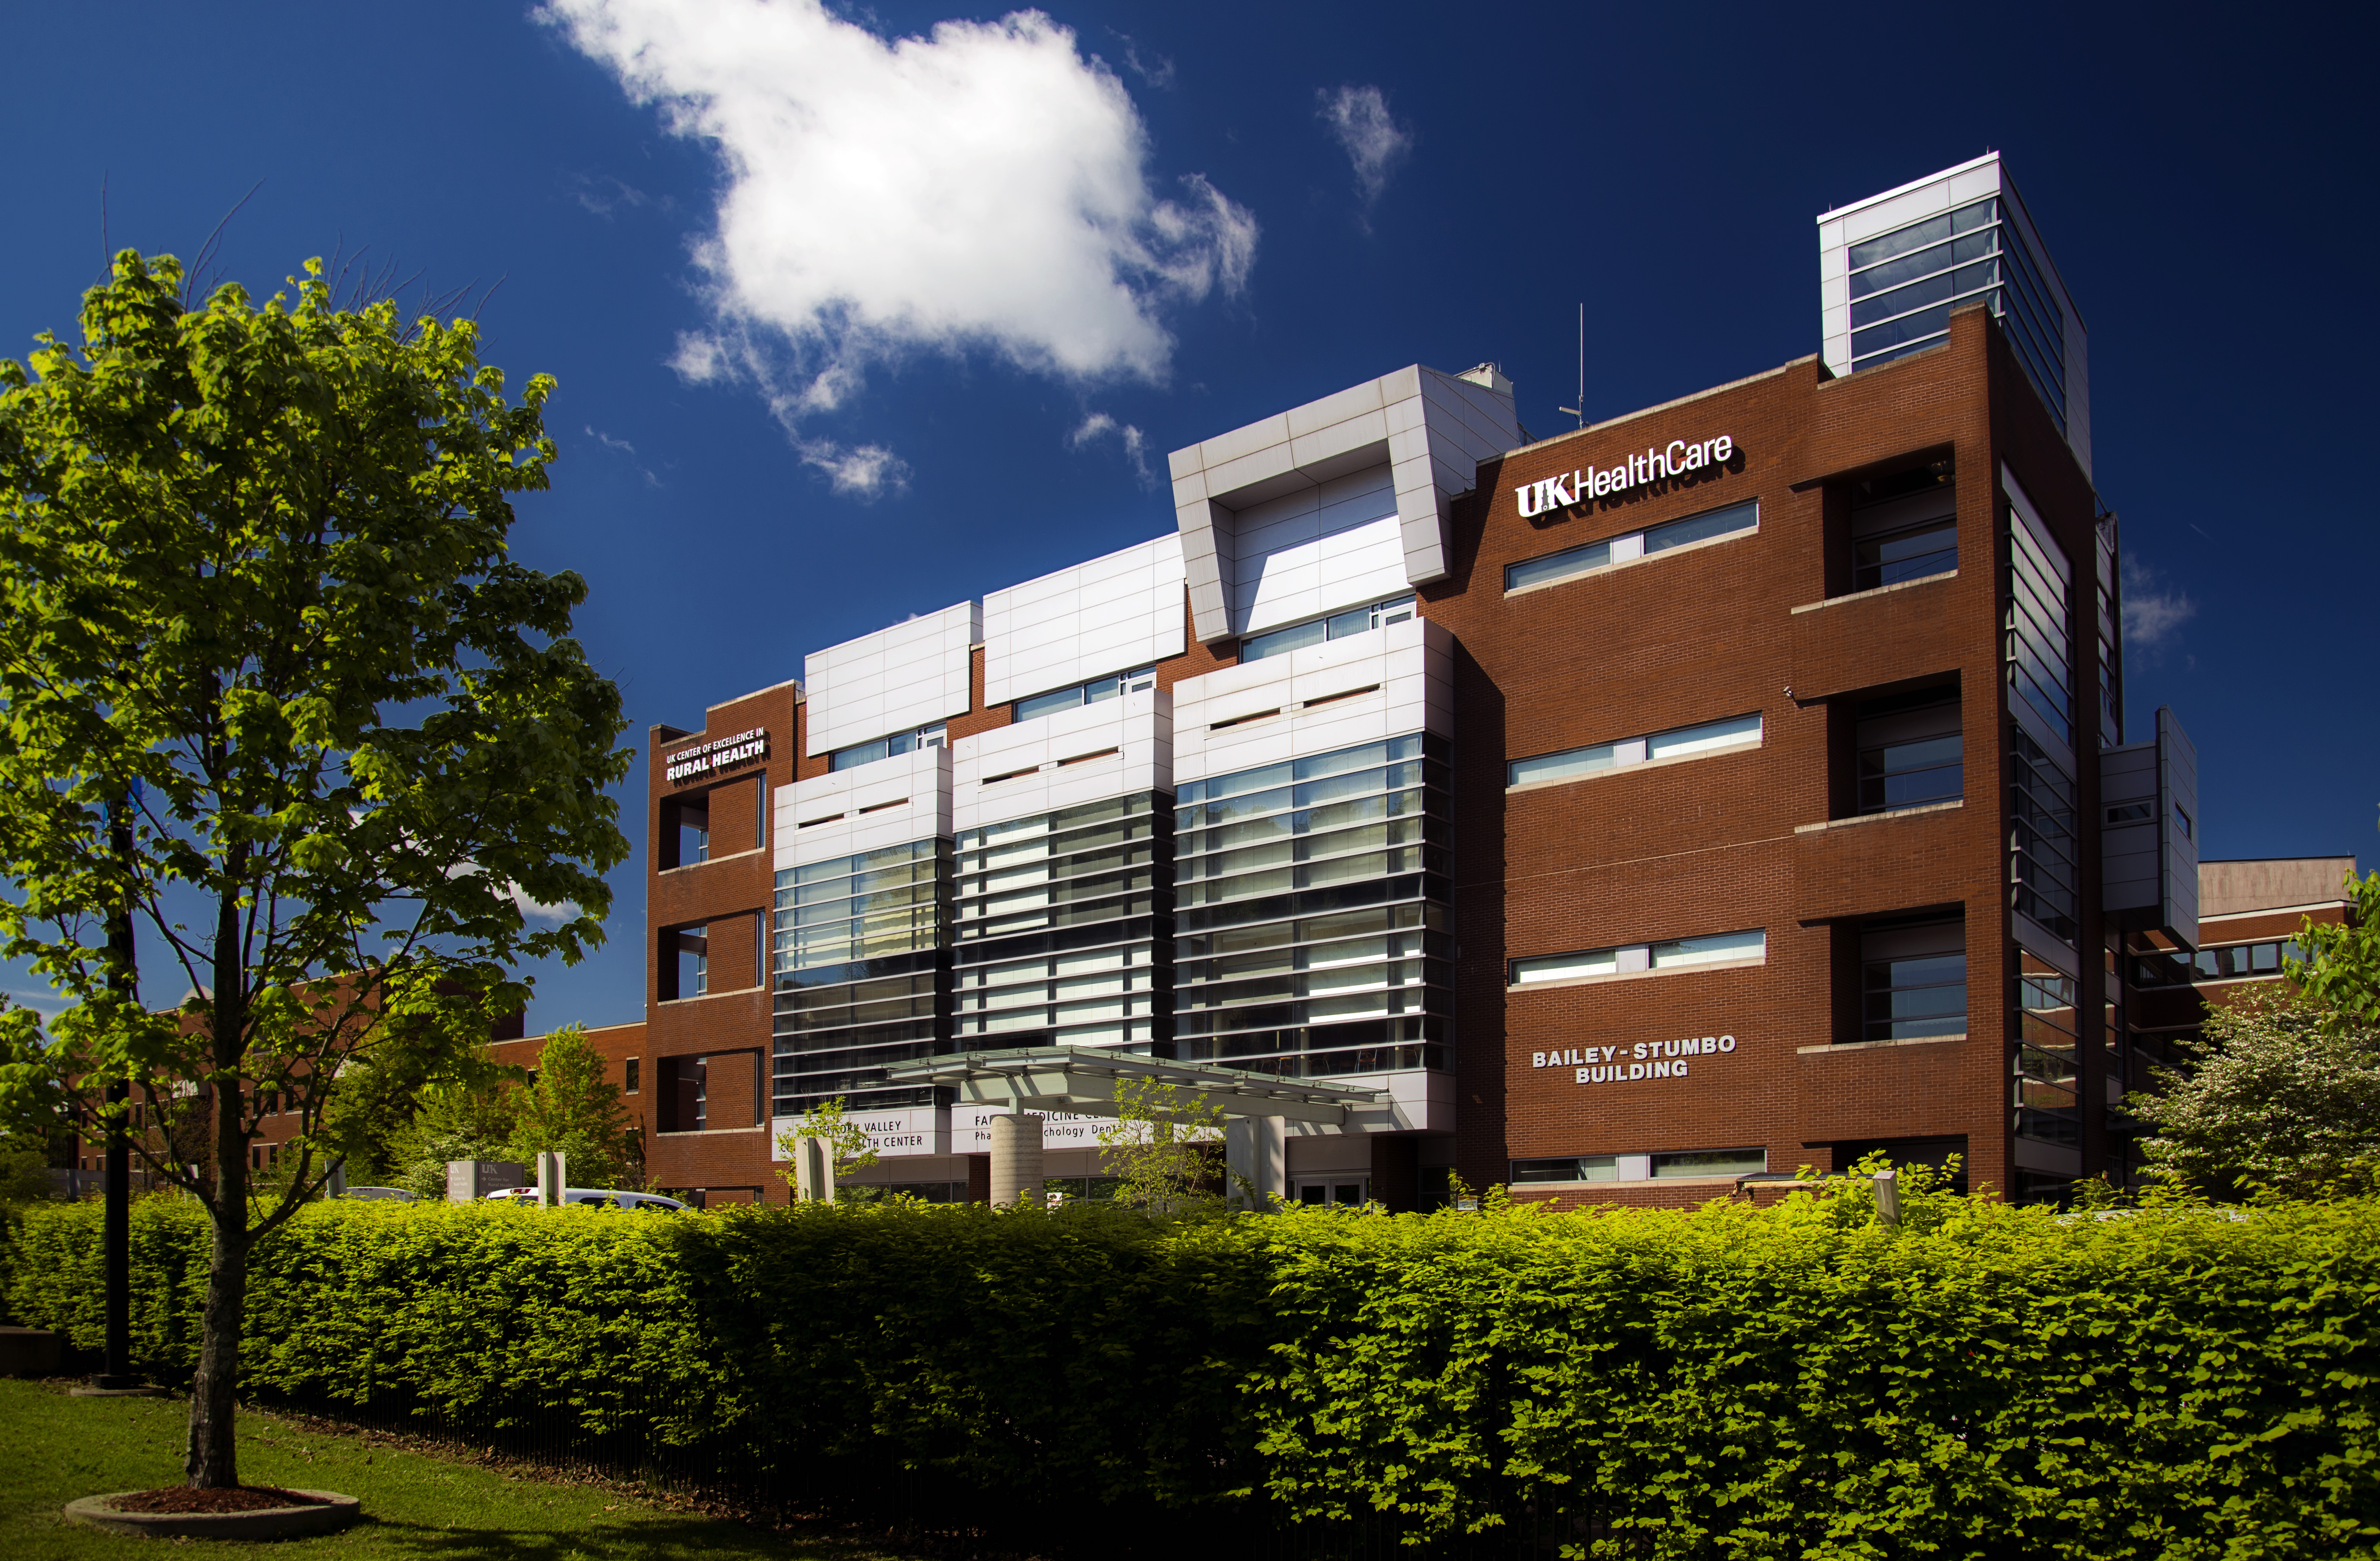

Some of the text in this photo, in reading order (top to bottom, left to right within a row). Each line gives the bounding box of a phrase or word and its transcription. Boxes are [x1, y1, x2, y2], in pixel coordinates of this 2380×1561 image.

[667, 727, 764, 764] UK CENTER OF EXCELLENCE IN
[667, 739, 764, 781] RURAL HEALTH
[1576, 1060, 1688, 1084] BUILDING
[834, 1123, 859, 1134] ORK
[864, 1120, 901, 1132] VALLEY
[1092, 1123, 1126, 1134] Dentl
[884, 1136, 922, 1147] CENTER
[450, 1164, 459, 1173] UK
[481, 1164, 498, 1174] UK
